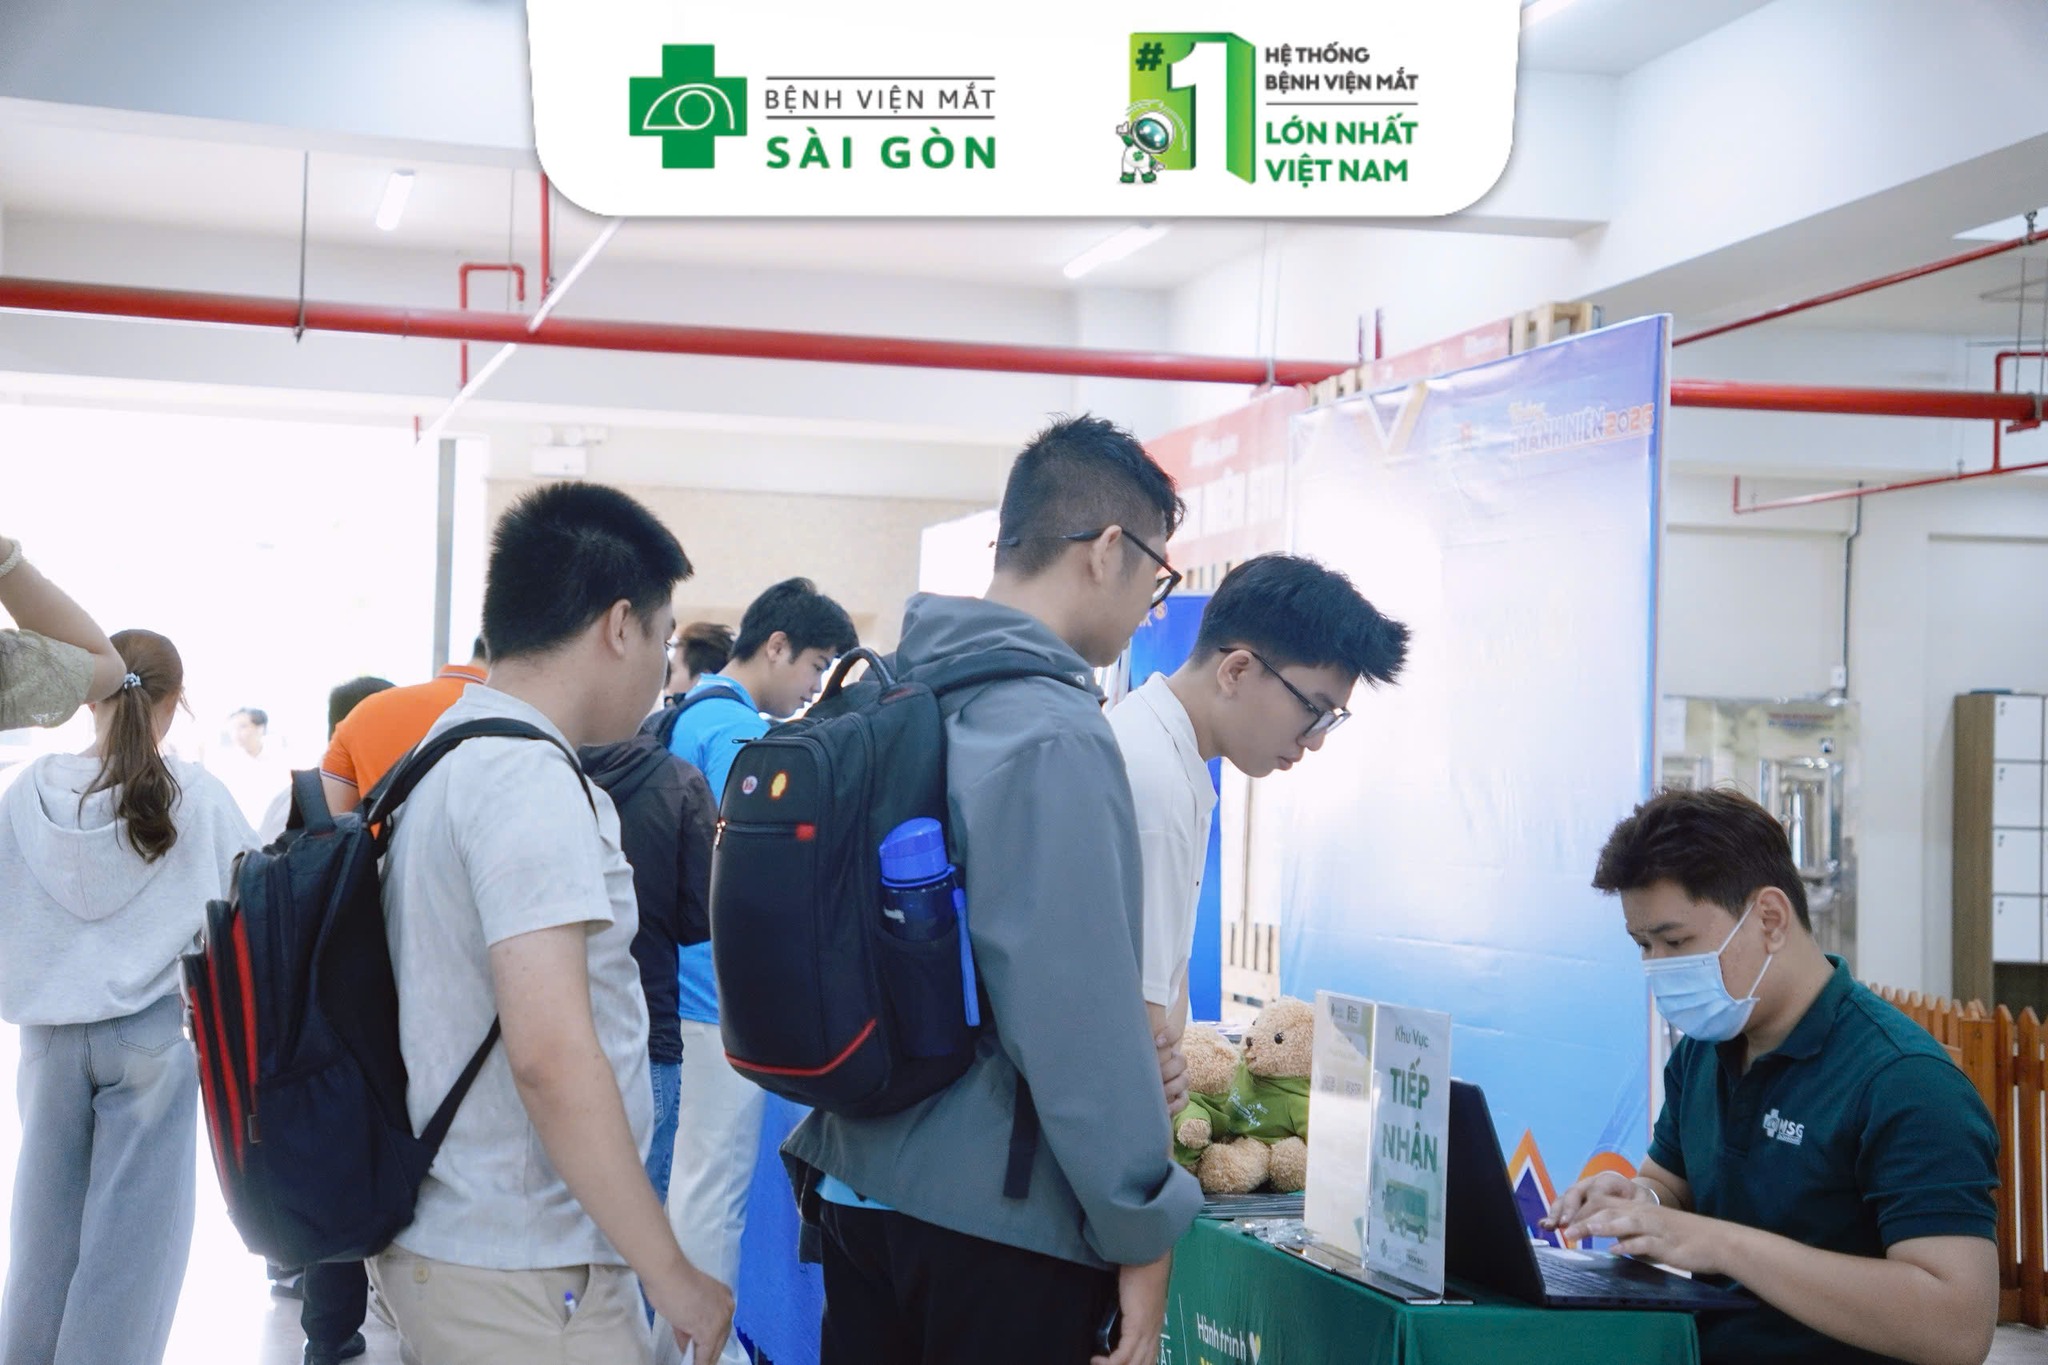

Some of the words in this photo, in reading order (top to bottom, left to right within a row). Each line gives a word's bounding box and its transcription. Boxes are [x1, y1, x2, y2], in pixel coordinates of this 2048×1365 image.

[1395, 1025, 1411, 1044] Khu
[1389, 1056, 1430, 1110] TIẾP
[1382, 1121, 1438, 1173] NHẬN
[1196, 1311, 1219, 1350] Hành
[1220, 1326, 1247, 1363] trình
